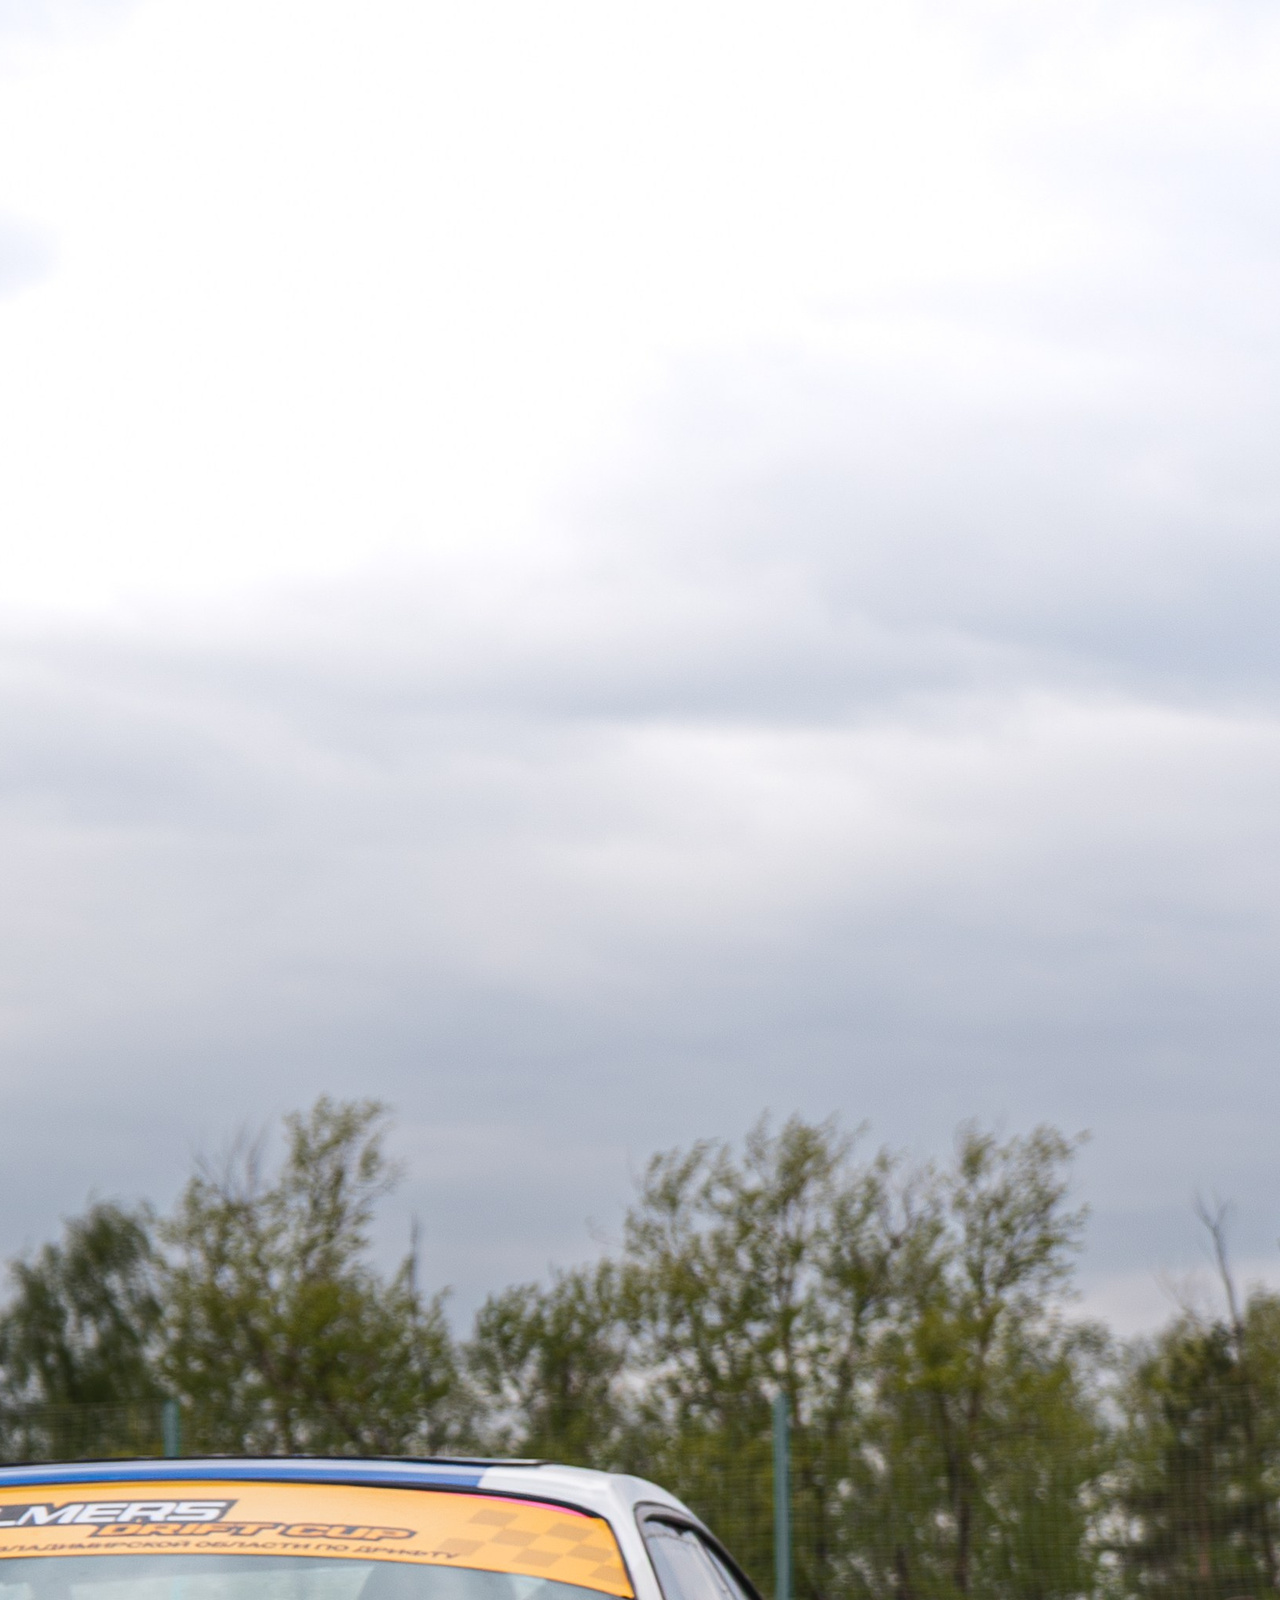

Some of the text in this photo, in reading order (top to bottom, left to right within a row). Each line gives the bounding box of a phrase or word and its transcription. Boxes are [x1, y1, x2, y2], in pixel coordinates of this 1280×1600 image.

[89, 1520, 415, 1540] DRIFT CUP
[194, 1540, 310, 1551] ОБЛАСТИ
[313, 1542, 350, 1552] ПО
[352, 1545, 462, 1560] ДРИФТУ
